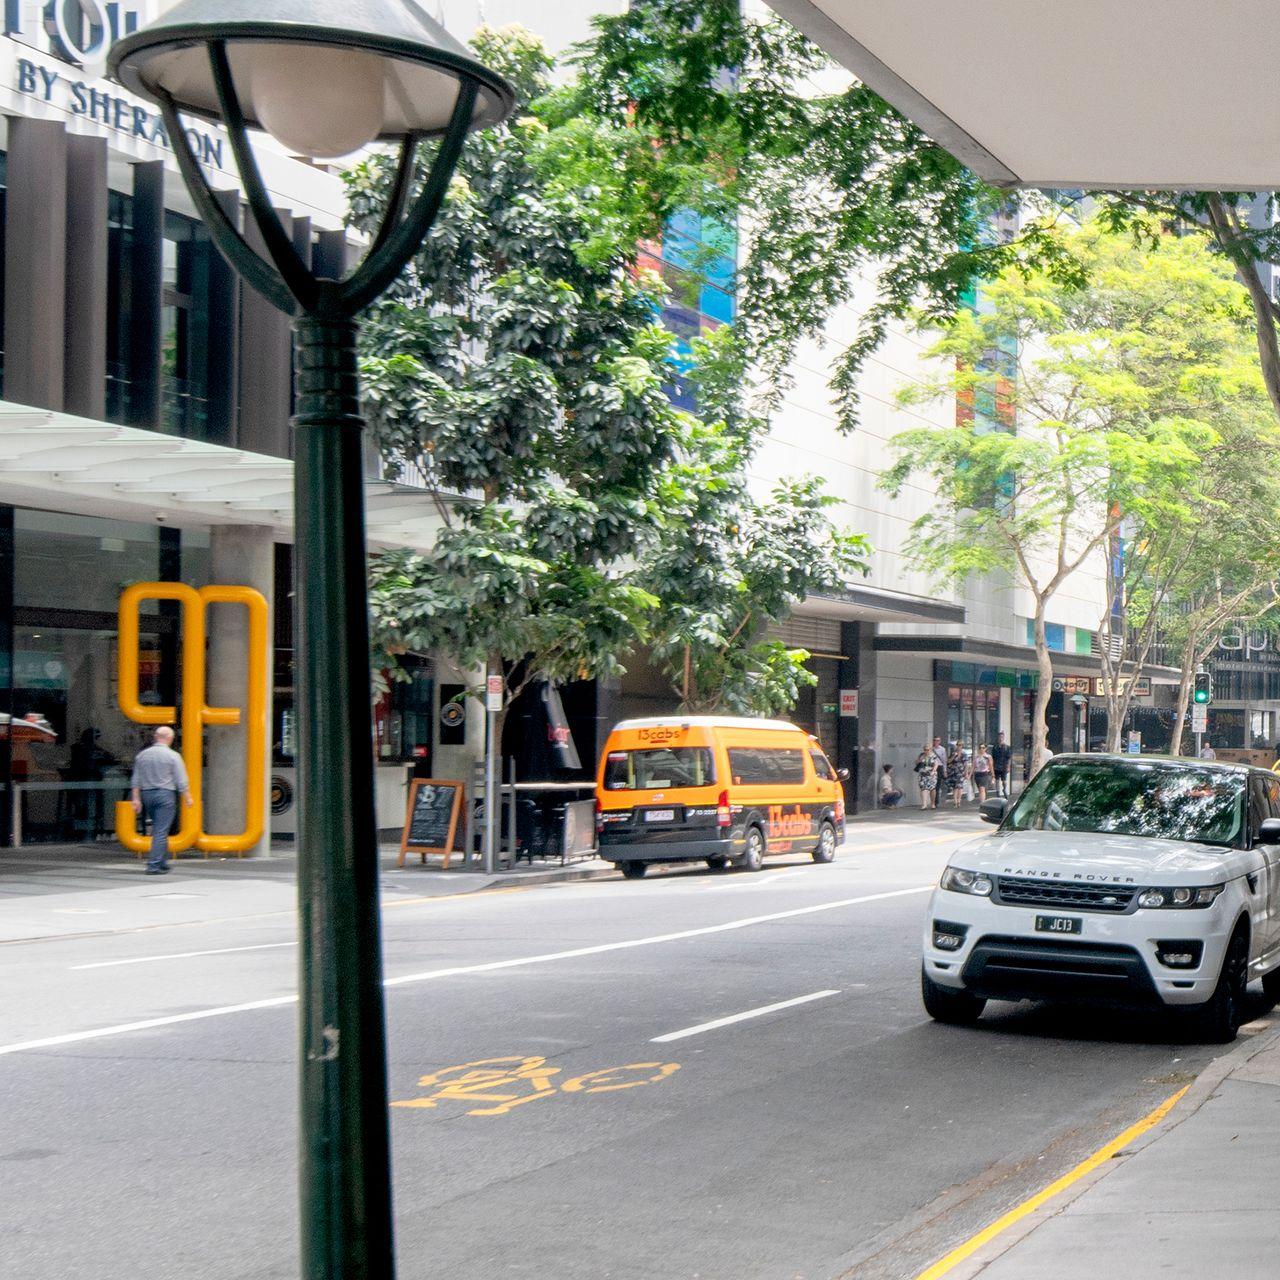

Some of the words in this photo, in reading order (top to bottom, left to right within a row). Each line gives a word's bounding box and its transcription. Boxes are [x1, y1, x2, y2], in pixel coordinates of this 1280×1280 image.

[18, 57, 58, 102] BY
[70, 80, 225, 170] SHERAON
[637, 729, 681, 741] 13cabs
[768, 804, 812, 837] 13cabs
[1003, 867, 1061, 878] RANGE
[1073, 873, 1135, 883] ROVER
[1050, 916, 1073, 931] JC13
